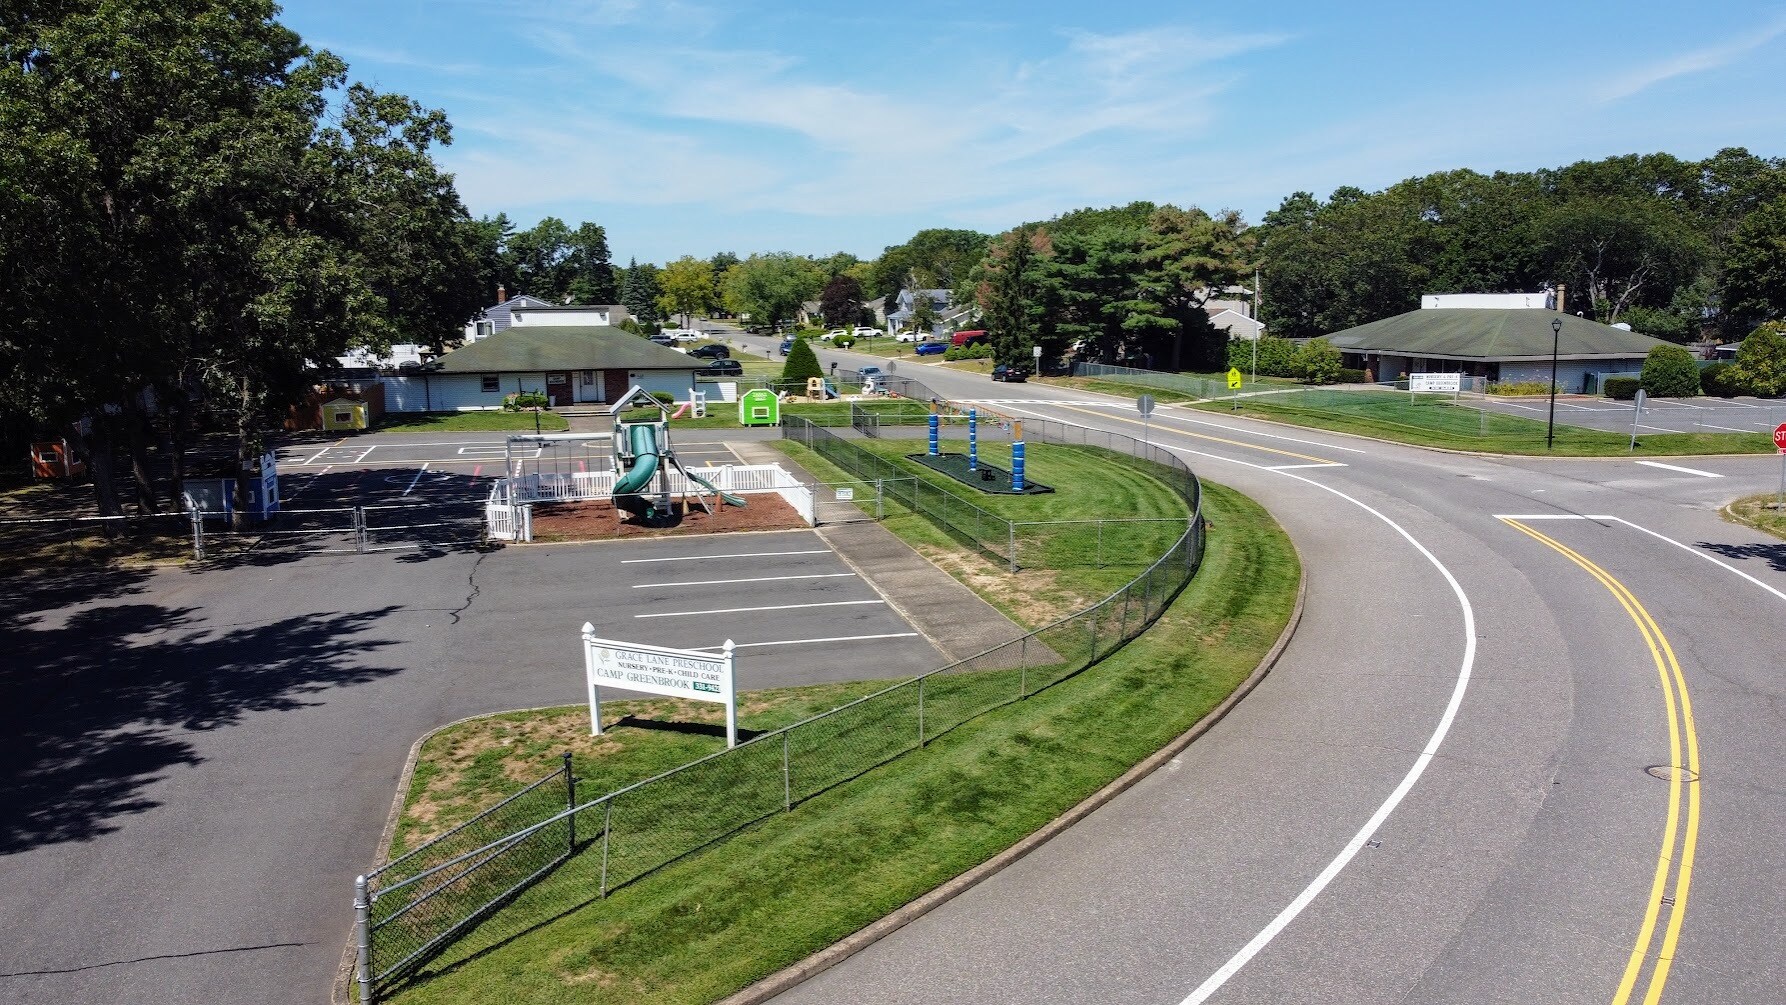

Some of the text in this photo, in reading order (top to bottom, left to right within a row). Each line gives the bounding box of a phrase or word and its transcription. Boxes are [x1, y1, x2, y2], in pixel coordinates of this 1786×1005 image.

[1775, 431, 1786, 441] ST
[615, 651, 724, 673] GRACE LANE PRESCHOOL
[618, 662, 720, 681] NURSERY PRE-K CHILD CARE
[597, 668, 623, 680] CAMP
[627, 672, 690, 689] GREENBROOK
